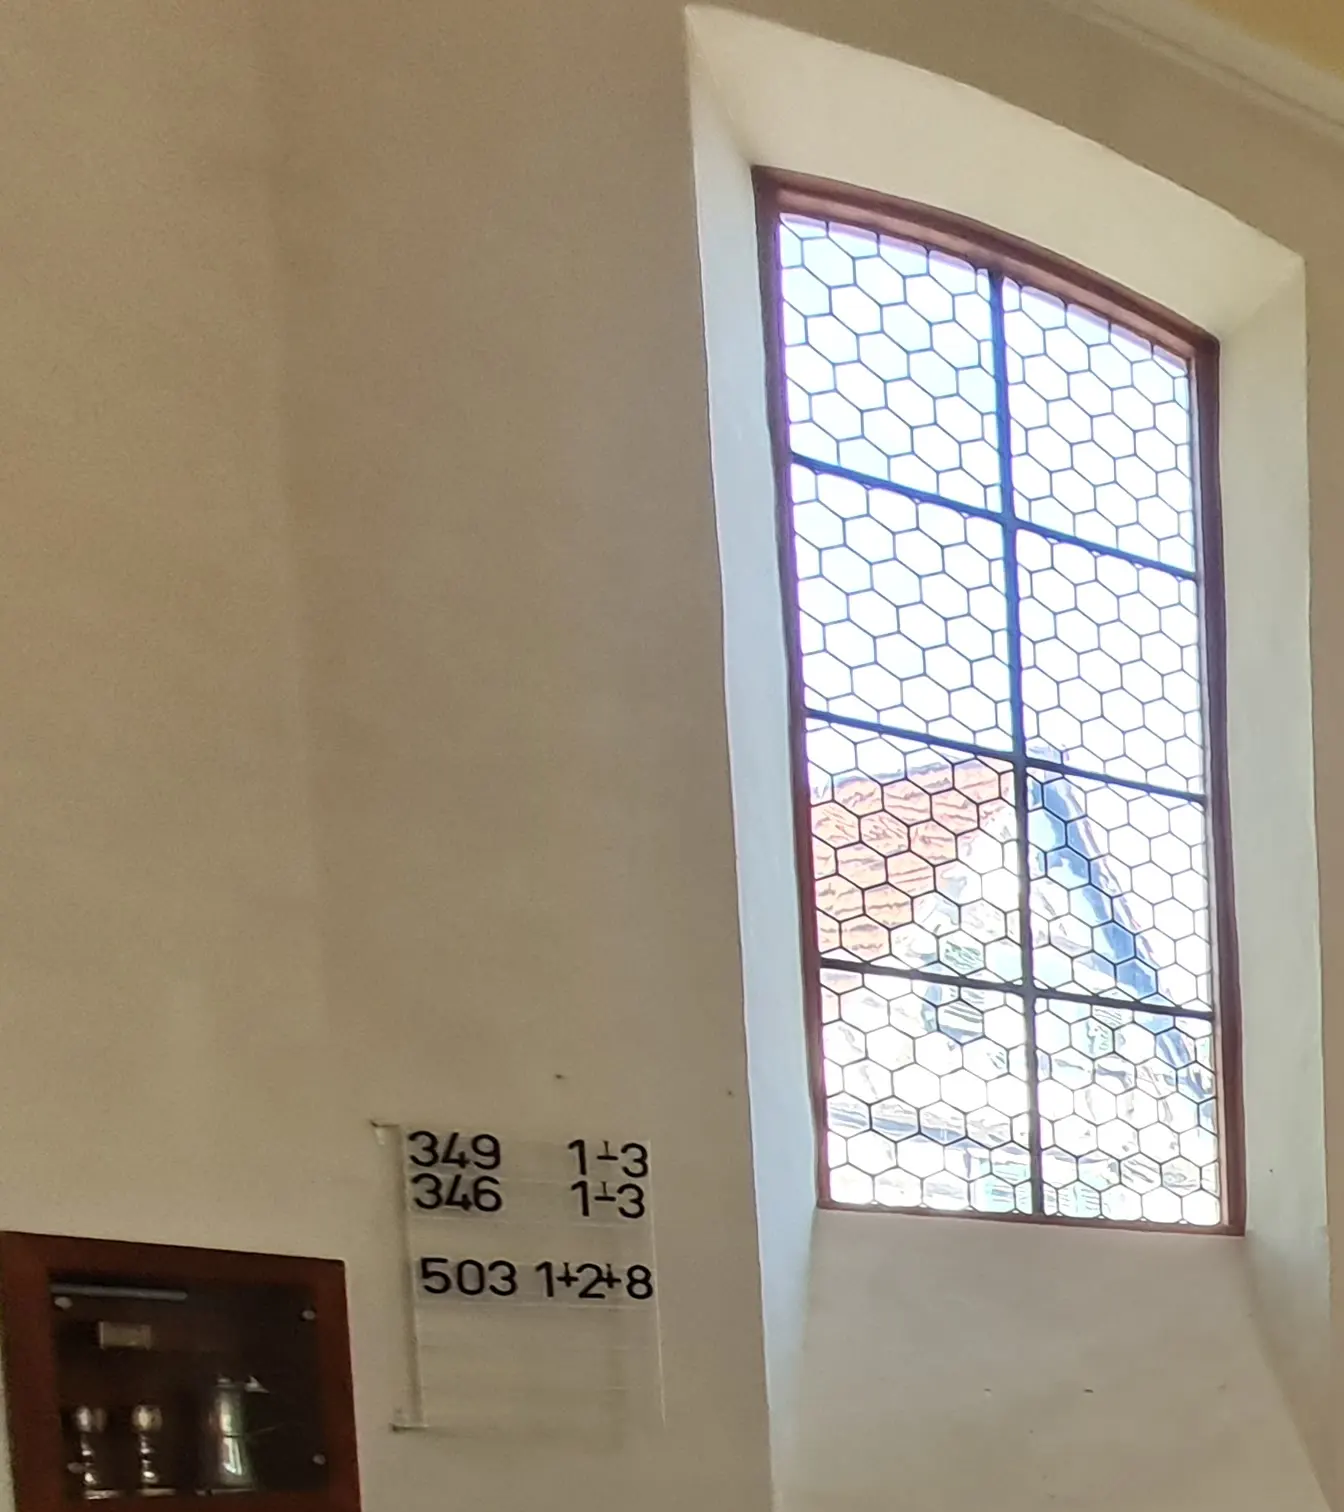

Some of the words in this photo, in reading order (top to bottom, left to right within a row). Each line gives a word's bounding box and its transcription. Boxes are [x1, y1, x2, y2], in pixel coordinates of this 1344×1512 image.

[408, 1130, 501, 1170] 349
[411, 1173, 503, 1212] 346
[420, 1257, 518, 1296] 503
[535, 1261, 654, 1300] 1+2+8
